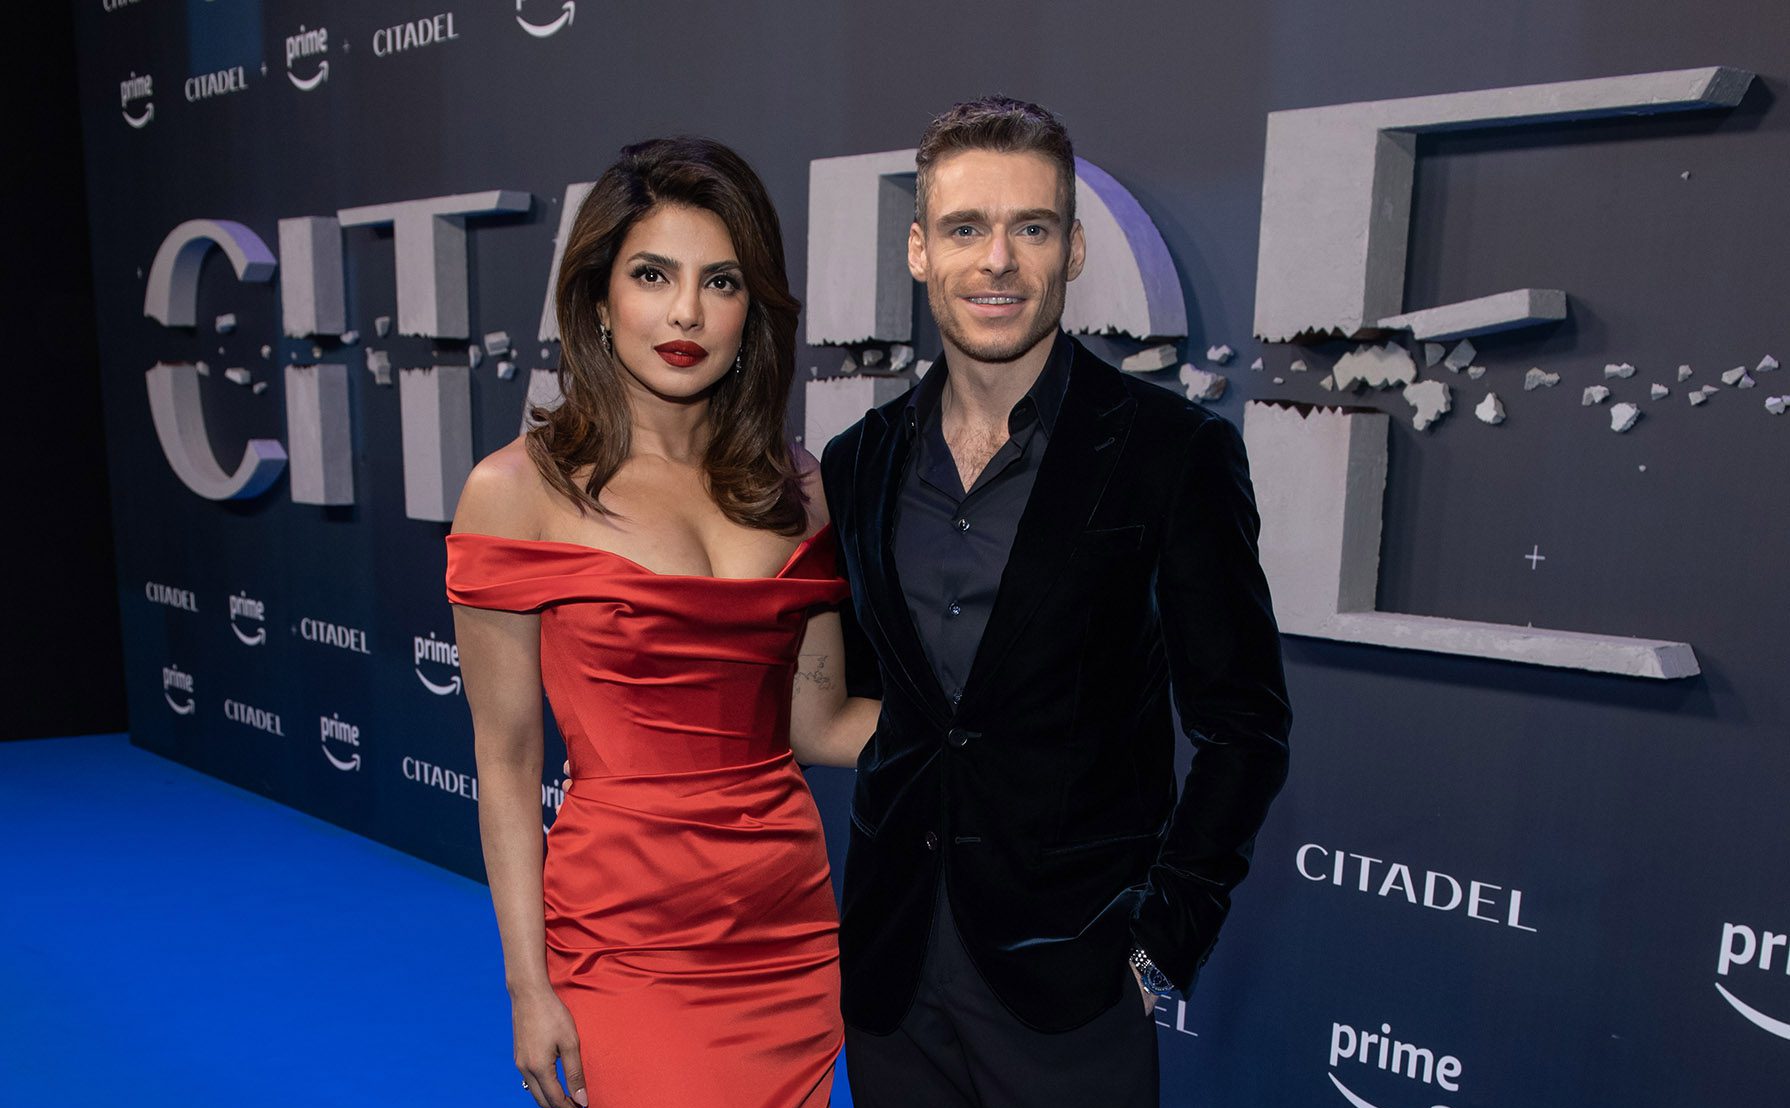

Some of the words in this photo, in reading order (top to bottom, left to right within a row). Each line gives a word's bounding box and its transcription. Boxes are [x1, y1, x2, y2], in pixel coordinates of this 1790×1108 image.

[286, 25, 329, 69] prime
[373, 13, 459, 57] CITADEL
[120, 71, 153, 107] prime
[184, 65, 248, 102] CITADEL
[146, 581, 199, 612] CITADEL
[229, 590, 265, 622] prime
[301, 617, 371, 654] CITADEL
[414, 631, 459, 667] prime
[163, 664, 193, 693] prime
[224, 698, 285, 737] CITADEL
[320, 712, 360, 747] prime
[1296, 843, 1538, 932] CITADEL
[1717, 922, 1790, 976] pr
[1328, 1023, 1463, 1092] prime
